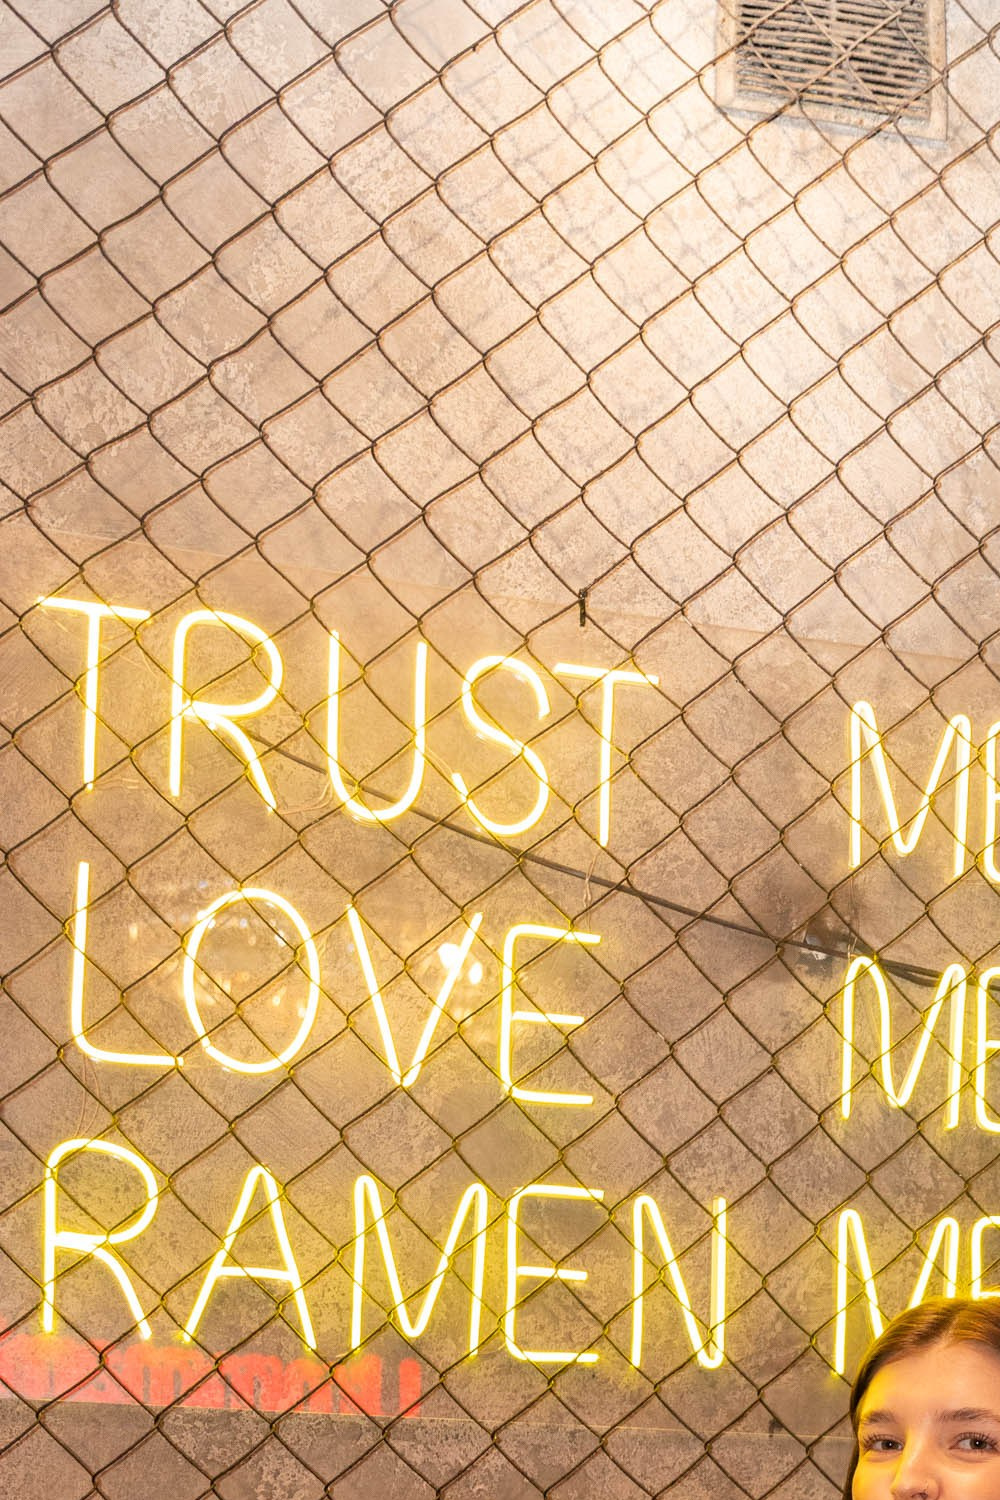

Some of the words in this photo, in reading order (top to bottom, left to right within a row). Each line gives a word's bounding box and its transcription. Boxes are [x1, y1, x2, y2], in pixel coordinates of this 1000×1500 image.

[36, 595, 660, 847] TRUST
[70, 860, 603, 1106] LOVE
[41, 1137, 727, 1371] RAMEN
